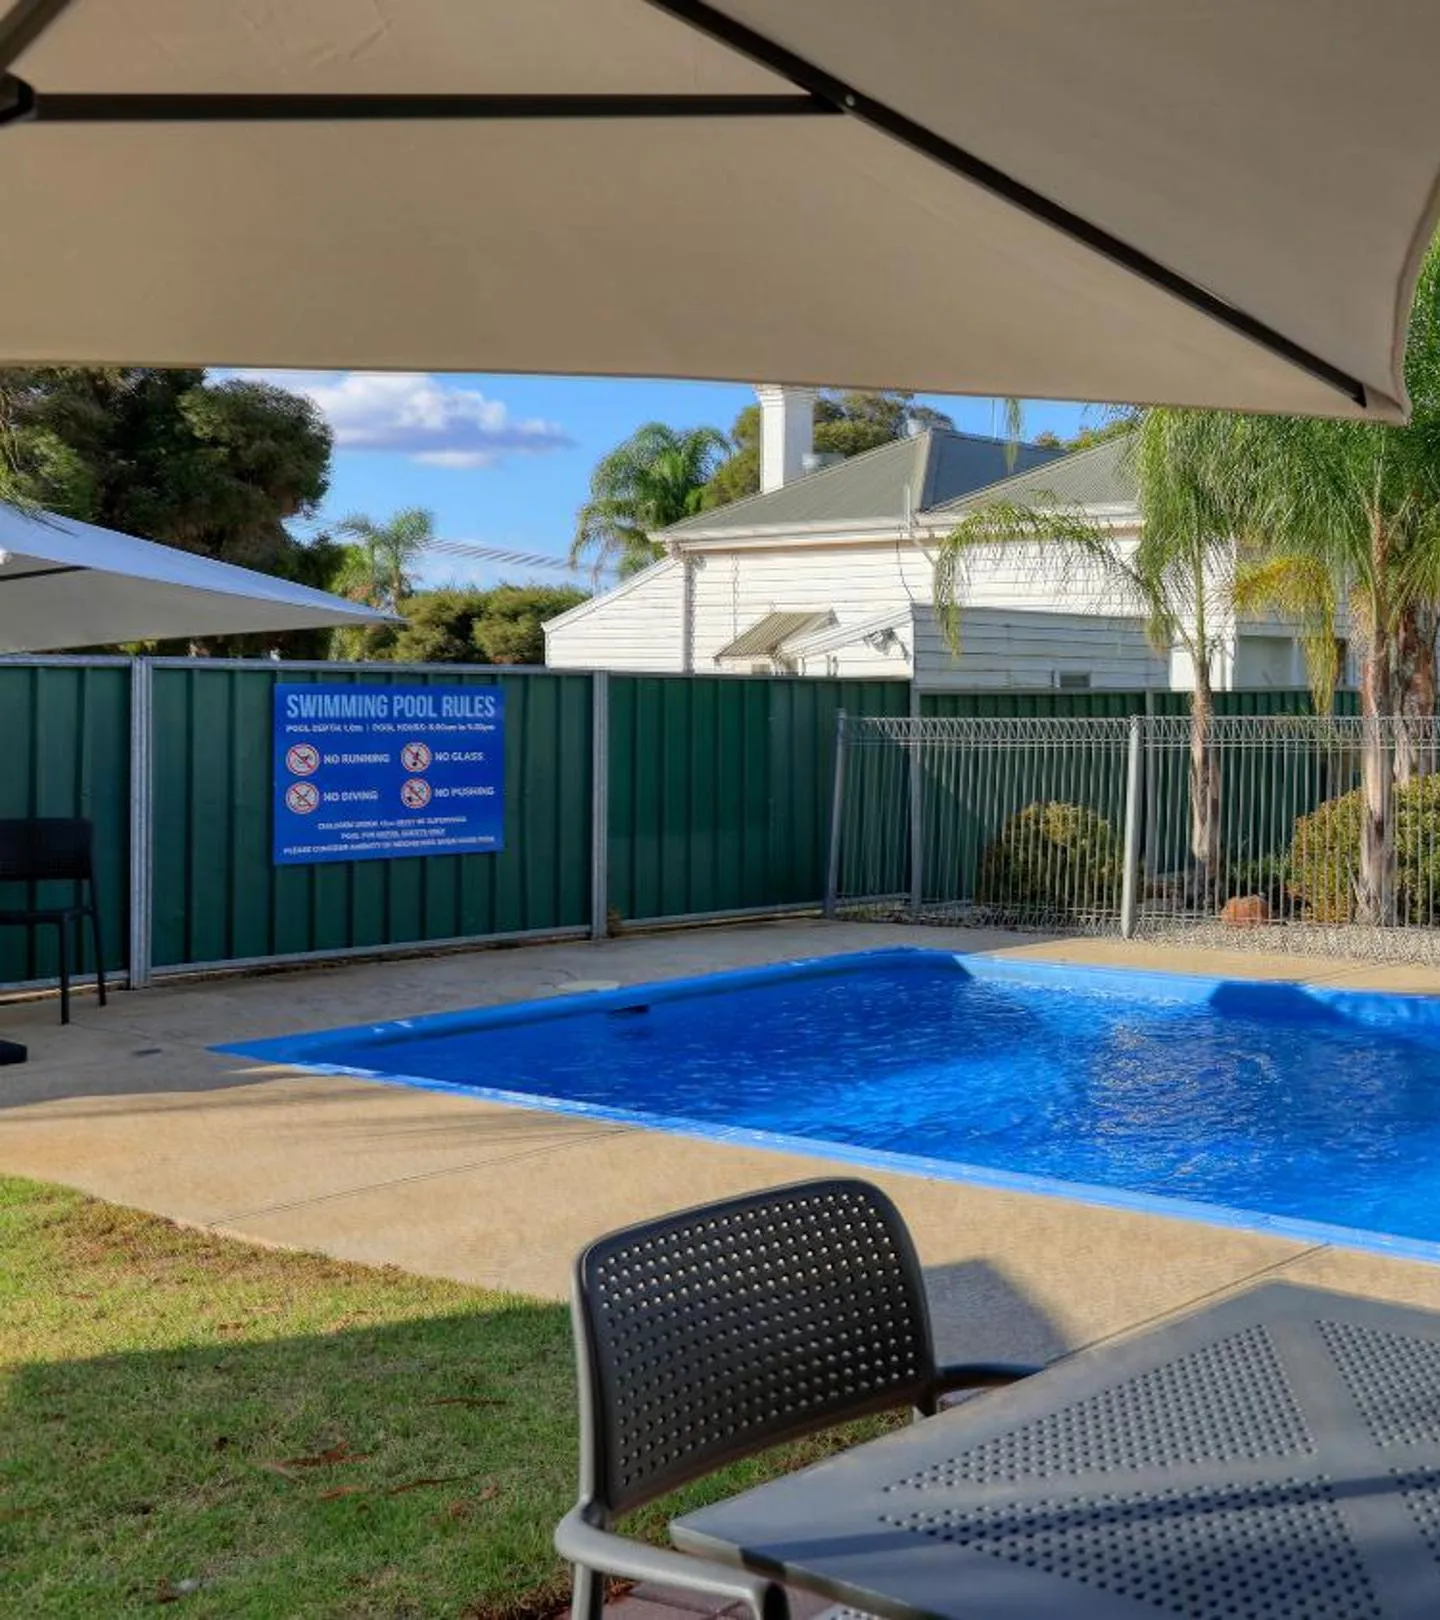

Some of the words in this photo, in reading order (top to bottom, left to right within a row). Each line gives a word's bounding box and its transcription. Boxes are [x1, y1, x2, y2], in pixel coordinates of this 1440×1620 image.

[286, 694, 388, 718] SWIMMING
[393, 695, 437, 717] POOL
[441, 695, 495, 717] RULES
[324, 754, 340, 764] NO
[342, 753, 390, 763] RUNNING
[435, 752, 449, 761] NO
[451, 751, 484, 761] GLASS
[324, 792, 340, 801] NO
[342, 790, 378, 801] DIVING
[435, 788, 449, 797] NO
[451, 786, 494, 796] PUSHING
